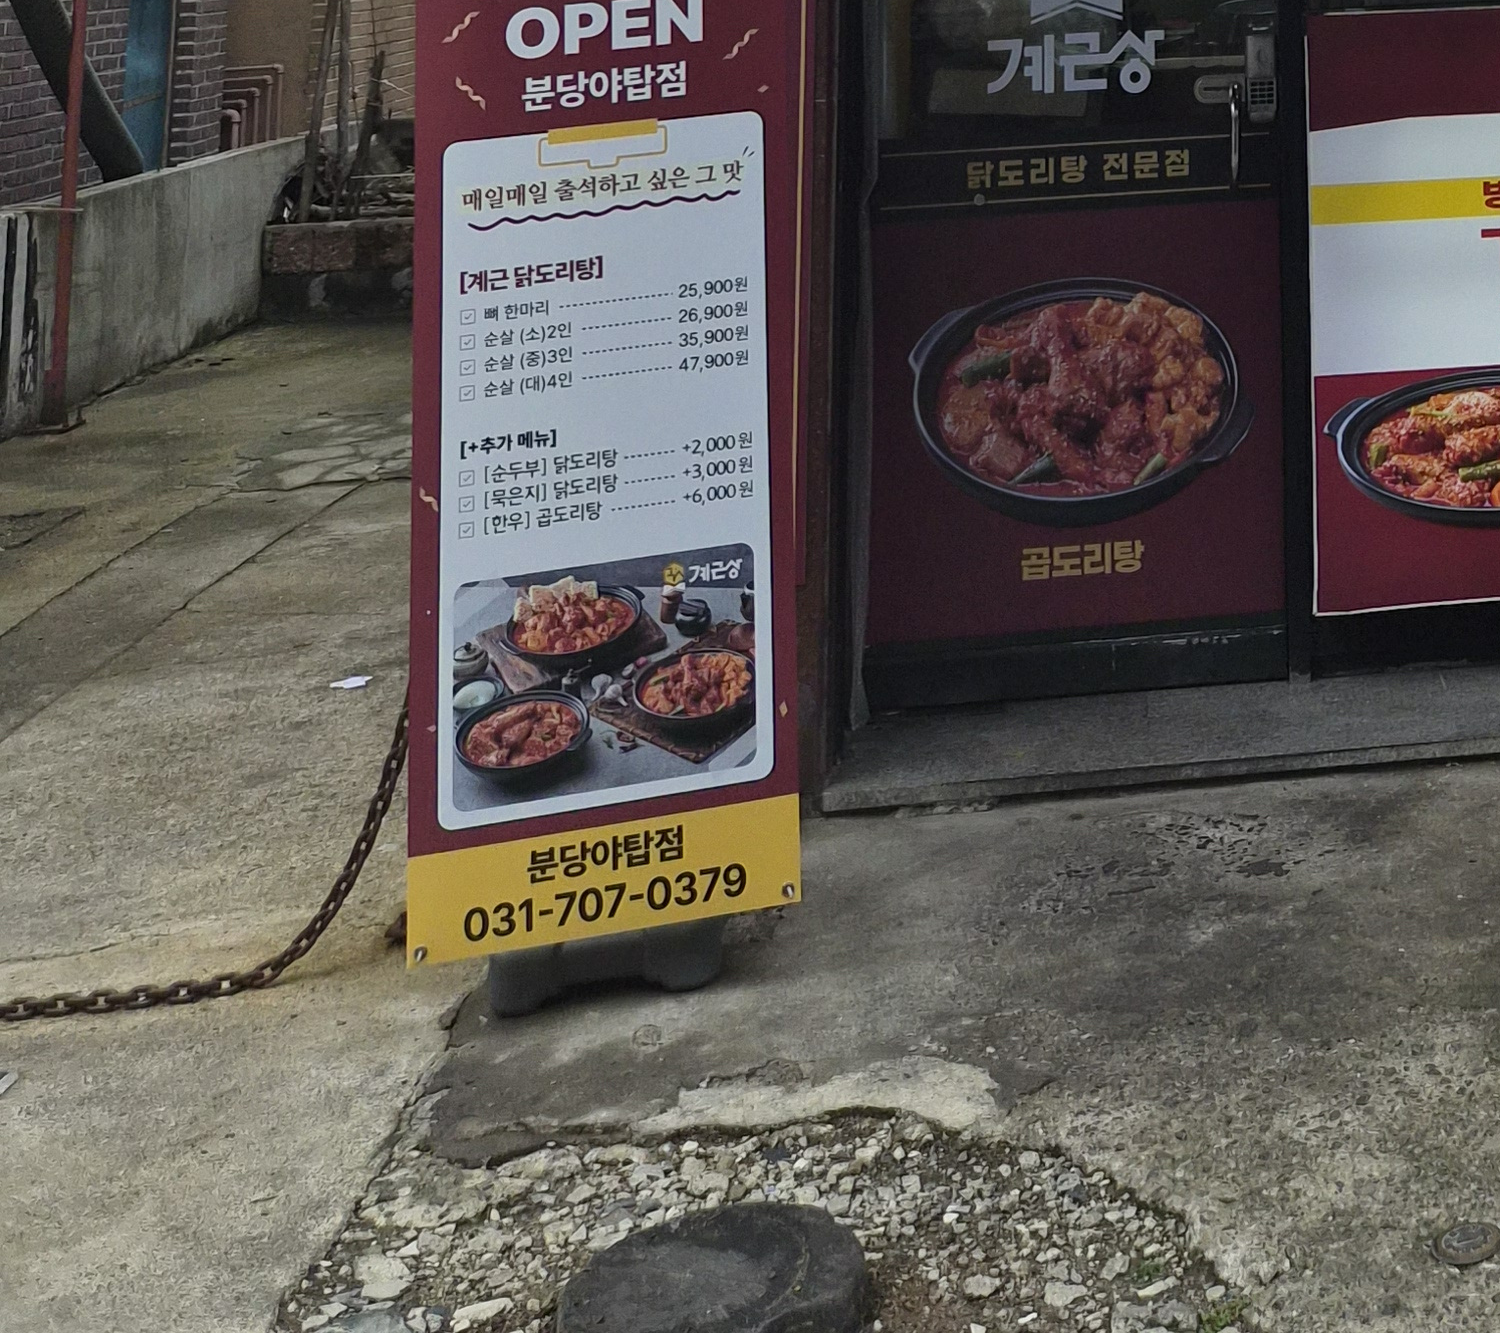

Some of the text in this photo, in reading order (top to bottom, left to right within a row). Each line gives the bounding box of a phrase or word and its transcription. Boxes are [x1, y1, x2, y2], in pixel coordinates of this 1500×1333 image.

[986, 29, 1165, 95] 계근상
[521, 60, 688, 113] 분당야탑점
[461, 159, 744, 213] 매일매일 출석하고 싶은 그 맛
[966, 148, 1191, 190] 닭도리탕 전문점
[459, 254, 605, 296] [계근 닭도리탕]
[503, 300, 550, 321] 한마리
[677, 276, 749, 300] 25,900원
[484, 301, 749, 348] 순살 (소)2인 26,900원
[484, 324, 750, 373] 순살 (중)3인 35,900원
[483, 349, 750, 399] 순살 (대)4인 47,900원
[459, 428, 558, 460] [+추가 메뉴]
[484, 457, 548, 484] [순두부]
[552, 447, 619, 476] 닭도리탕
[484, 482, 548, 511] [묵은지]
[552, 473, 619, 502] 닭도리탕
[484, 510, 531, 536] [한우]
[536, 501, 603, 529] 곱도리탕
[688, 558, 743, 584] 계근상
[1020, 539, 1145, 582] 곱도리탕
[526, 824, 685, 885] 분당야탑점
[462, 862, 748, 943] 031-707-0379
